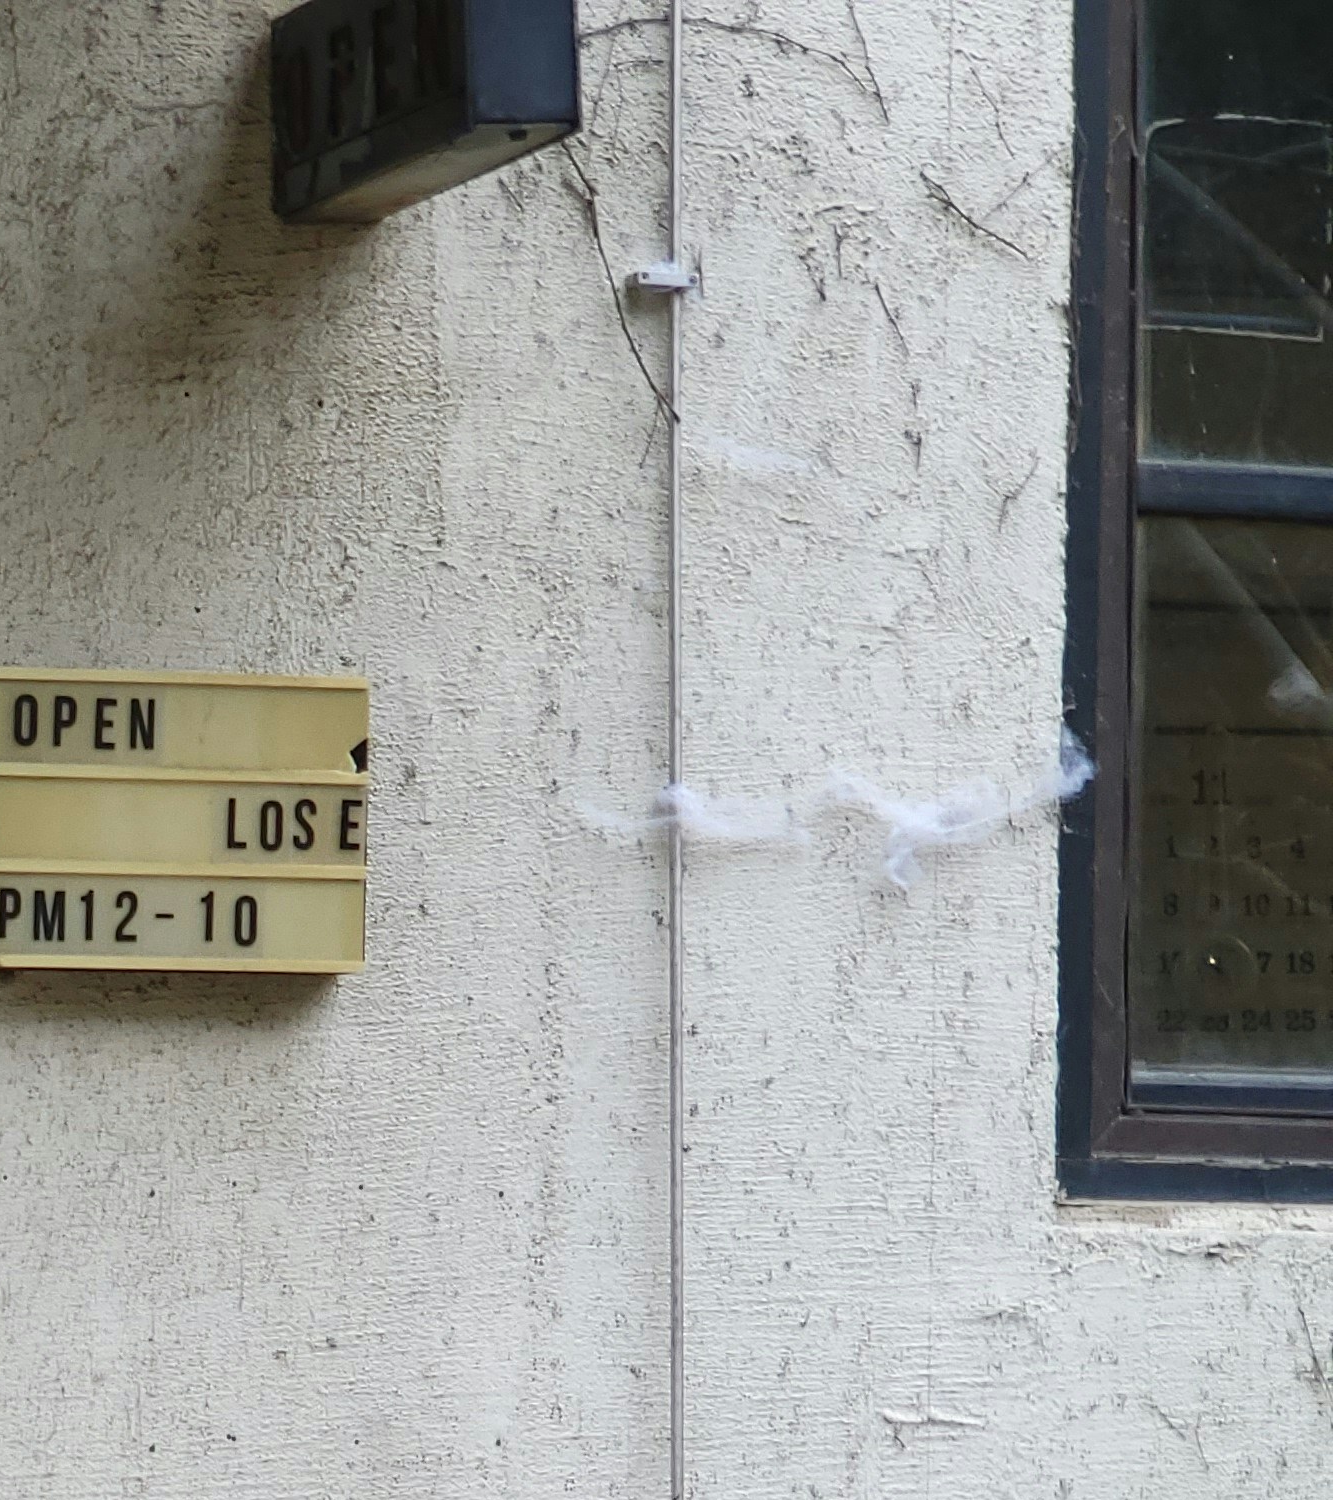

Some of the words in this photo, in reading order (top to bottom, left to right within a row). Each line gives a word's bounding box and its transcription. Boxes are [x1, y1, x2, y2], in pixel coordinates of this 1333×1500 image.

[13, 694, 156, 751] OPEN
[226, 798, 363, 851] LOSE
[1163, 894, 1178, 916] 8
[1244, 894, 1270, 916] 10
[1286, 951, 1316, 974] 18
